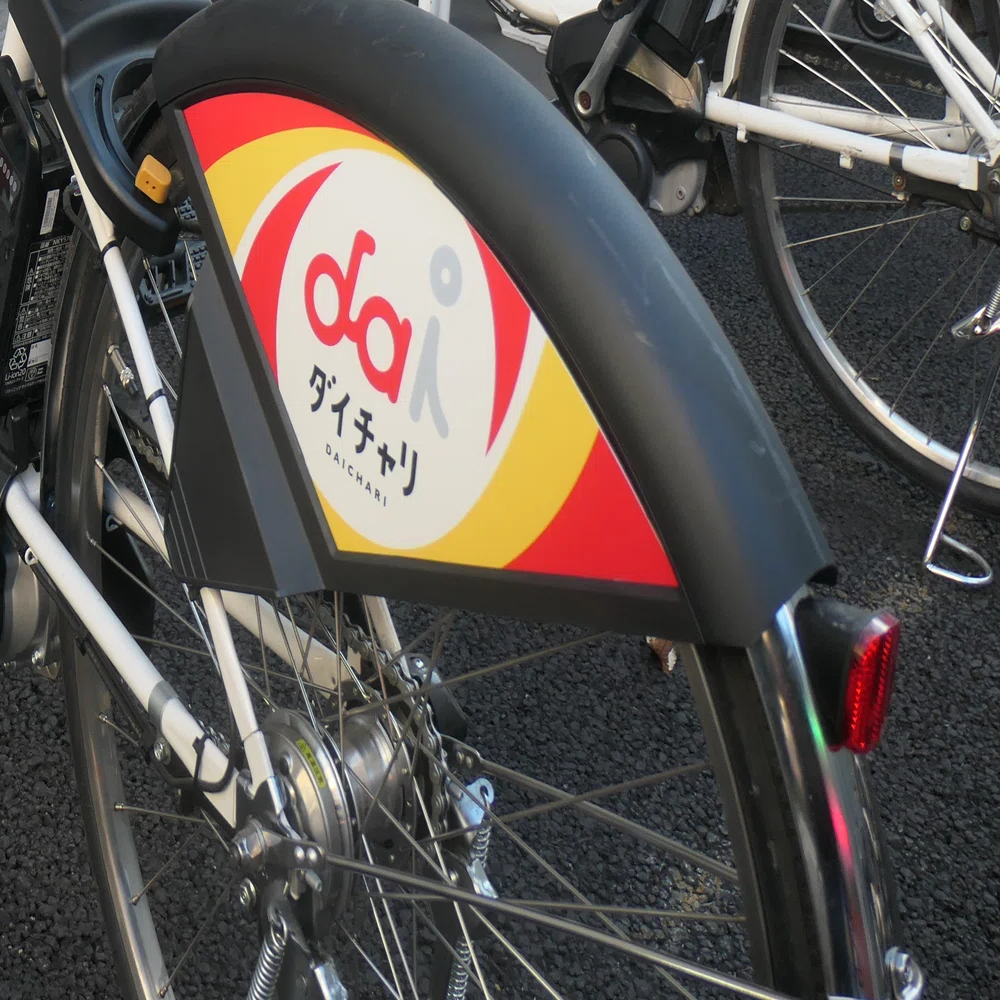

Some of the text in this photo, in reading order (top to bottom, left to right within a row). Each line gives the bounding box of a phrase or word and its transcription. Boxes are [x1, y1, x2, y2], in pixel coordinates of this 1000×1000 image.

[304, 229, 462, 439] dai
[309, 364, 418, 497] ダイチャリ
[325, 443, 388, 507] DAICHARI
